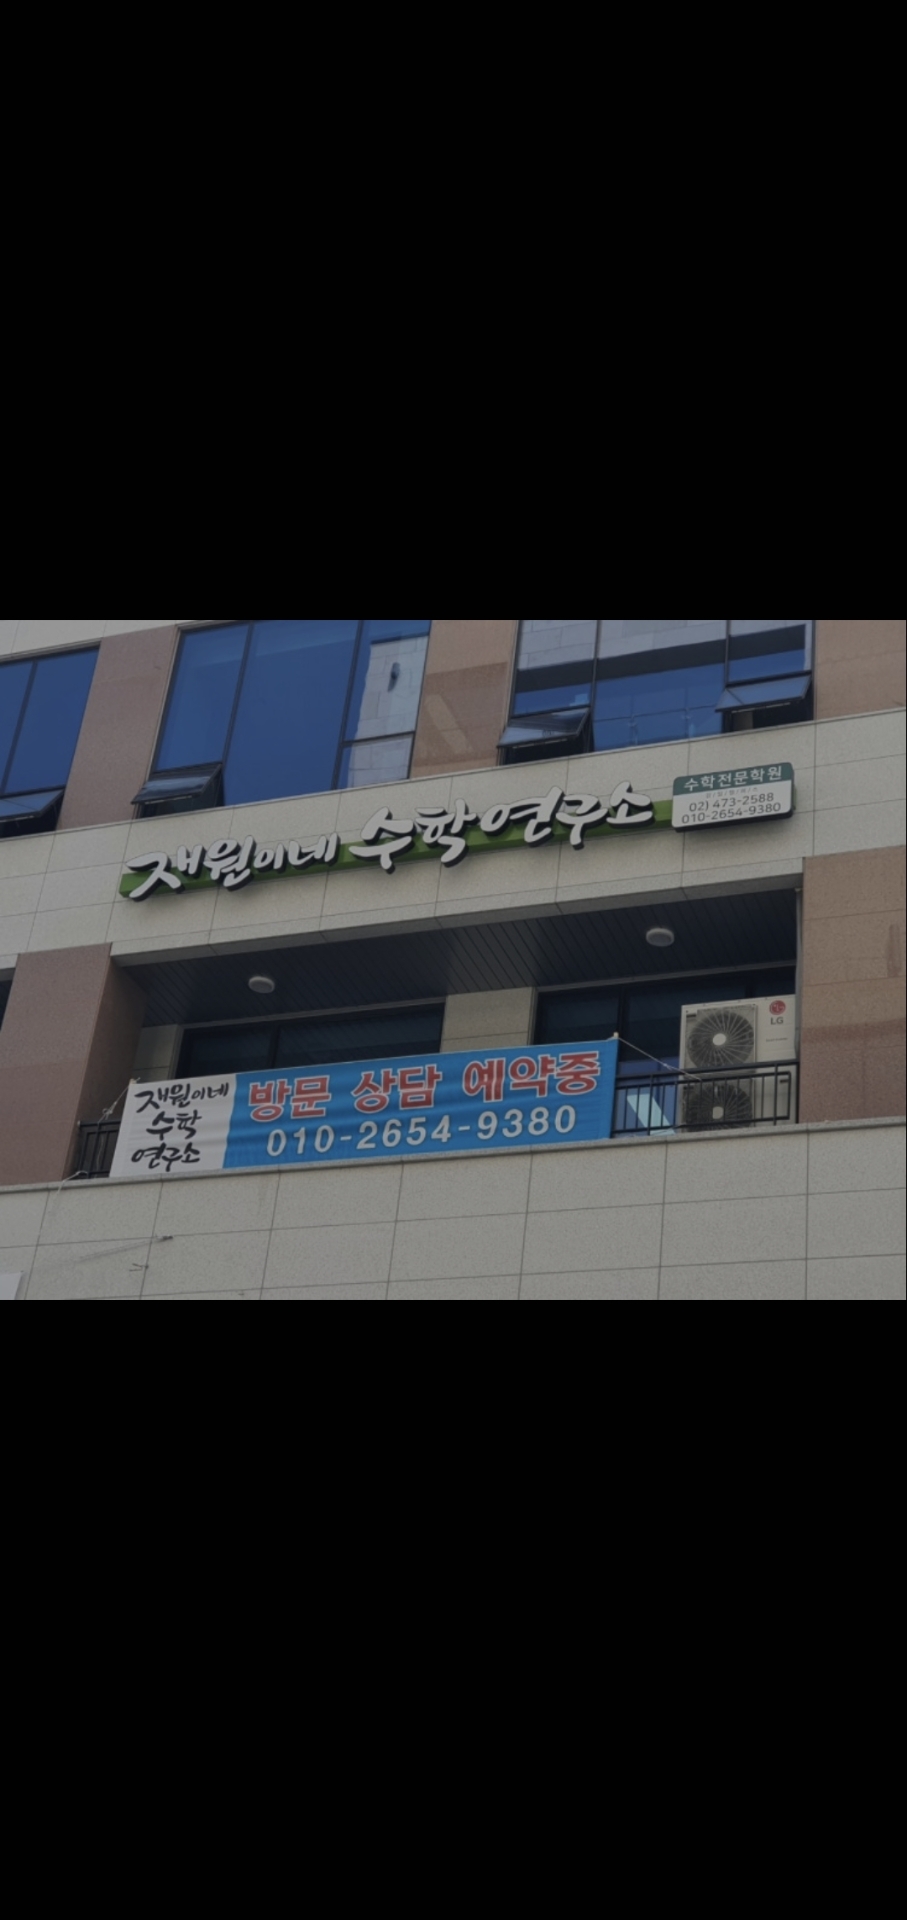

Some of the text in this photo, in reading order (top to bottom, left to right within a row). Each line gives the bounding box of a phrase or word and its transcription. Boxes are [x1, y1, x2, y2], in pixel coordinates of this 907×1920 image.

[684, 765, 782, 792] 수학전문학원
[681, 802, 781, 824] 010-2654-9380
[689, 800, 709, 812] 02)
[712, 792, 774, 808] 473-2588
[126, 781, 654, 900] 재원이네 수학 연구소
[770, 1016, 784, 1026] LG
[134, 1082, 229, 1113] 재원이네
[249, 1051, 601, 1122] 방문 상담 예약중
[146, 1109, 202, 1141] 수학
[266, 1105, 576, 1156] 010-2654-9380
[131, 1142, 200, 1172] 연구소
